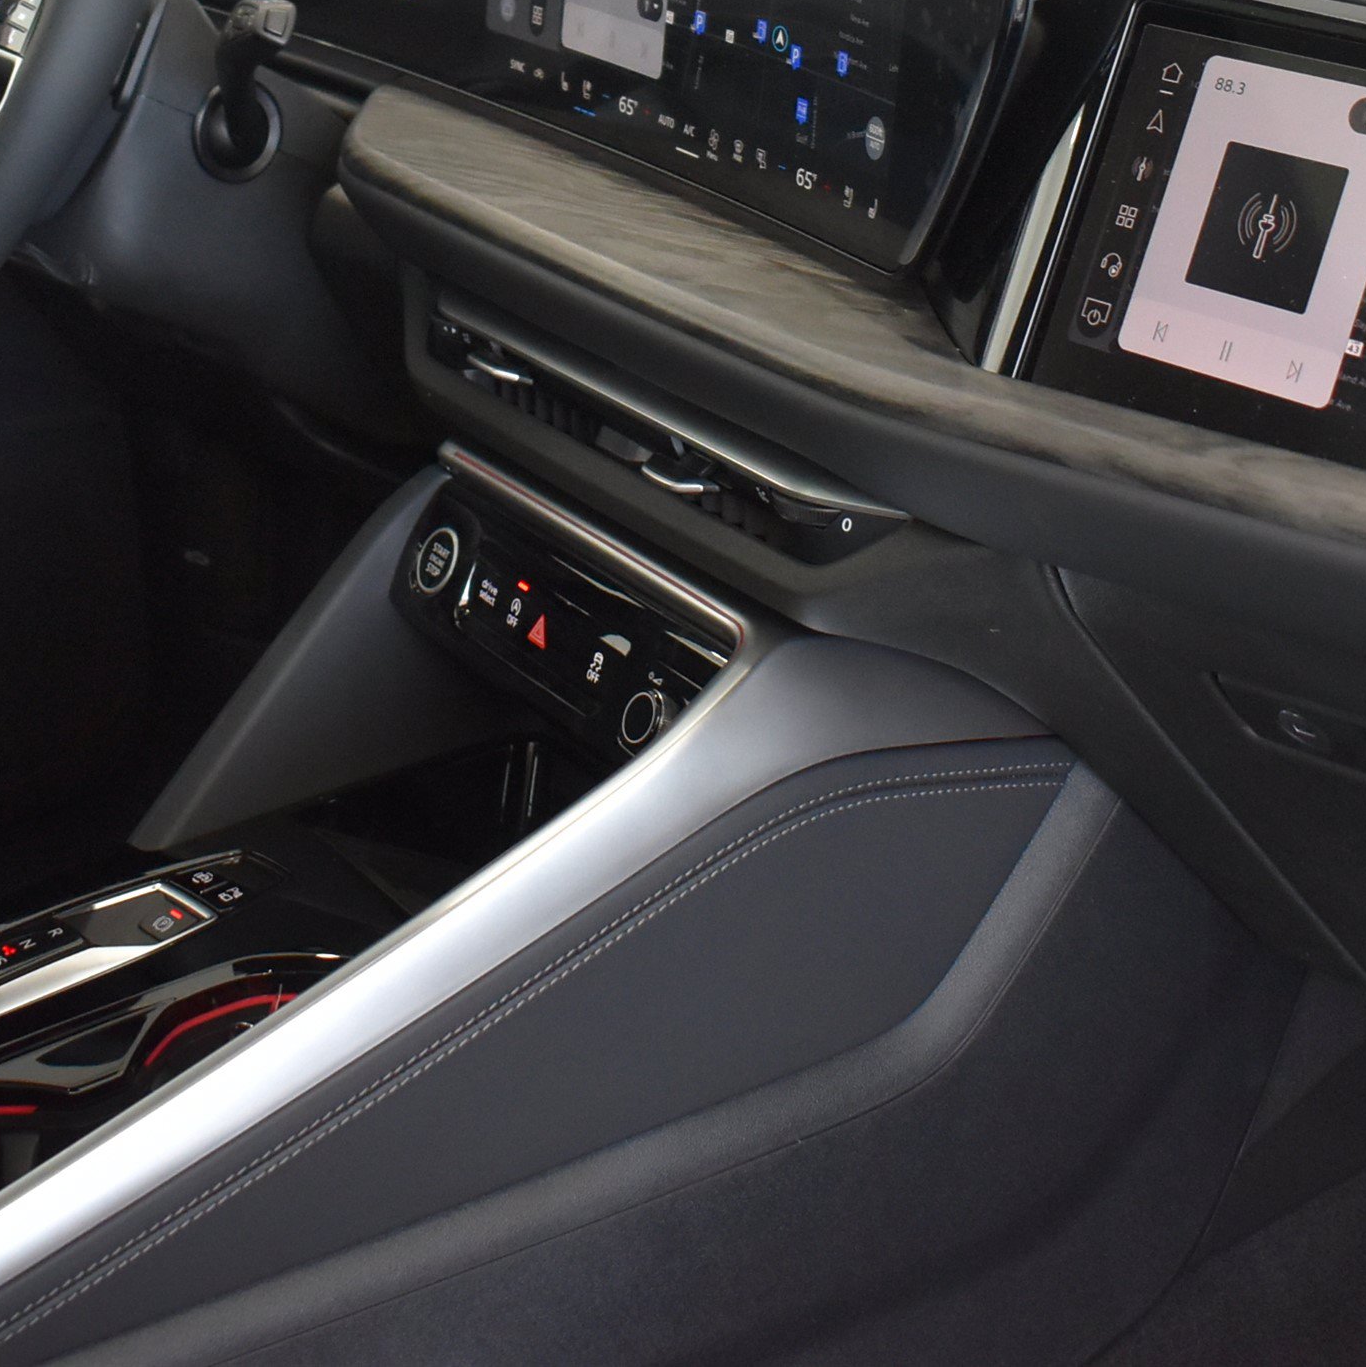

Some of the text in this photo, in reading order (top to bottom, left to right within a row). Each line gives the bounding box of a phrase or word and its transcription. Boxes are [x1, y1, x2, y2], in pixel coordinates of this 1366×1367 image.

[1213, 77, 1246, 96] 88.3
[658, 114, 675, 129] AUTO
[683, 124, 696, 137] A/C
[1347, 344, 1360, 354] 43
[433, 542, 451, 556] START
[424, 562, 441, 577] STOP
[481, 578, 498, 597] drive
[505, 614, 519, 628] OFF
[586, 668, 602, 685] OFF
[48, 927, 64, 939] R
[19, 937, 37, 950] N
